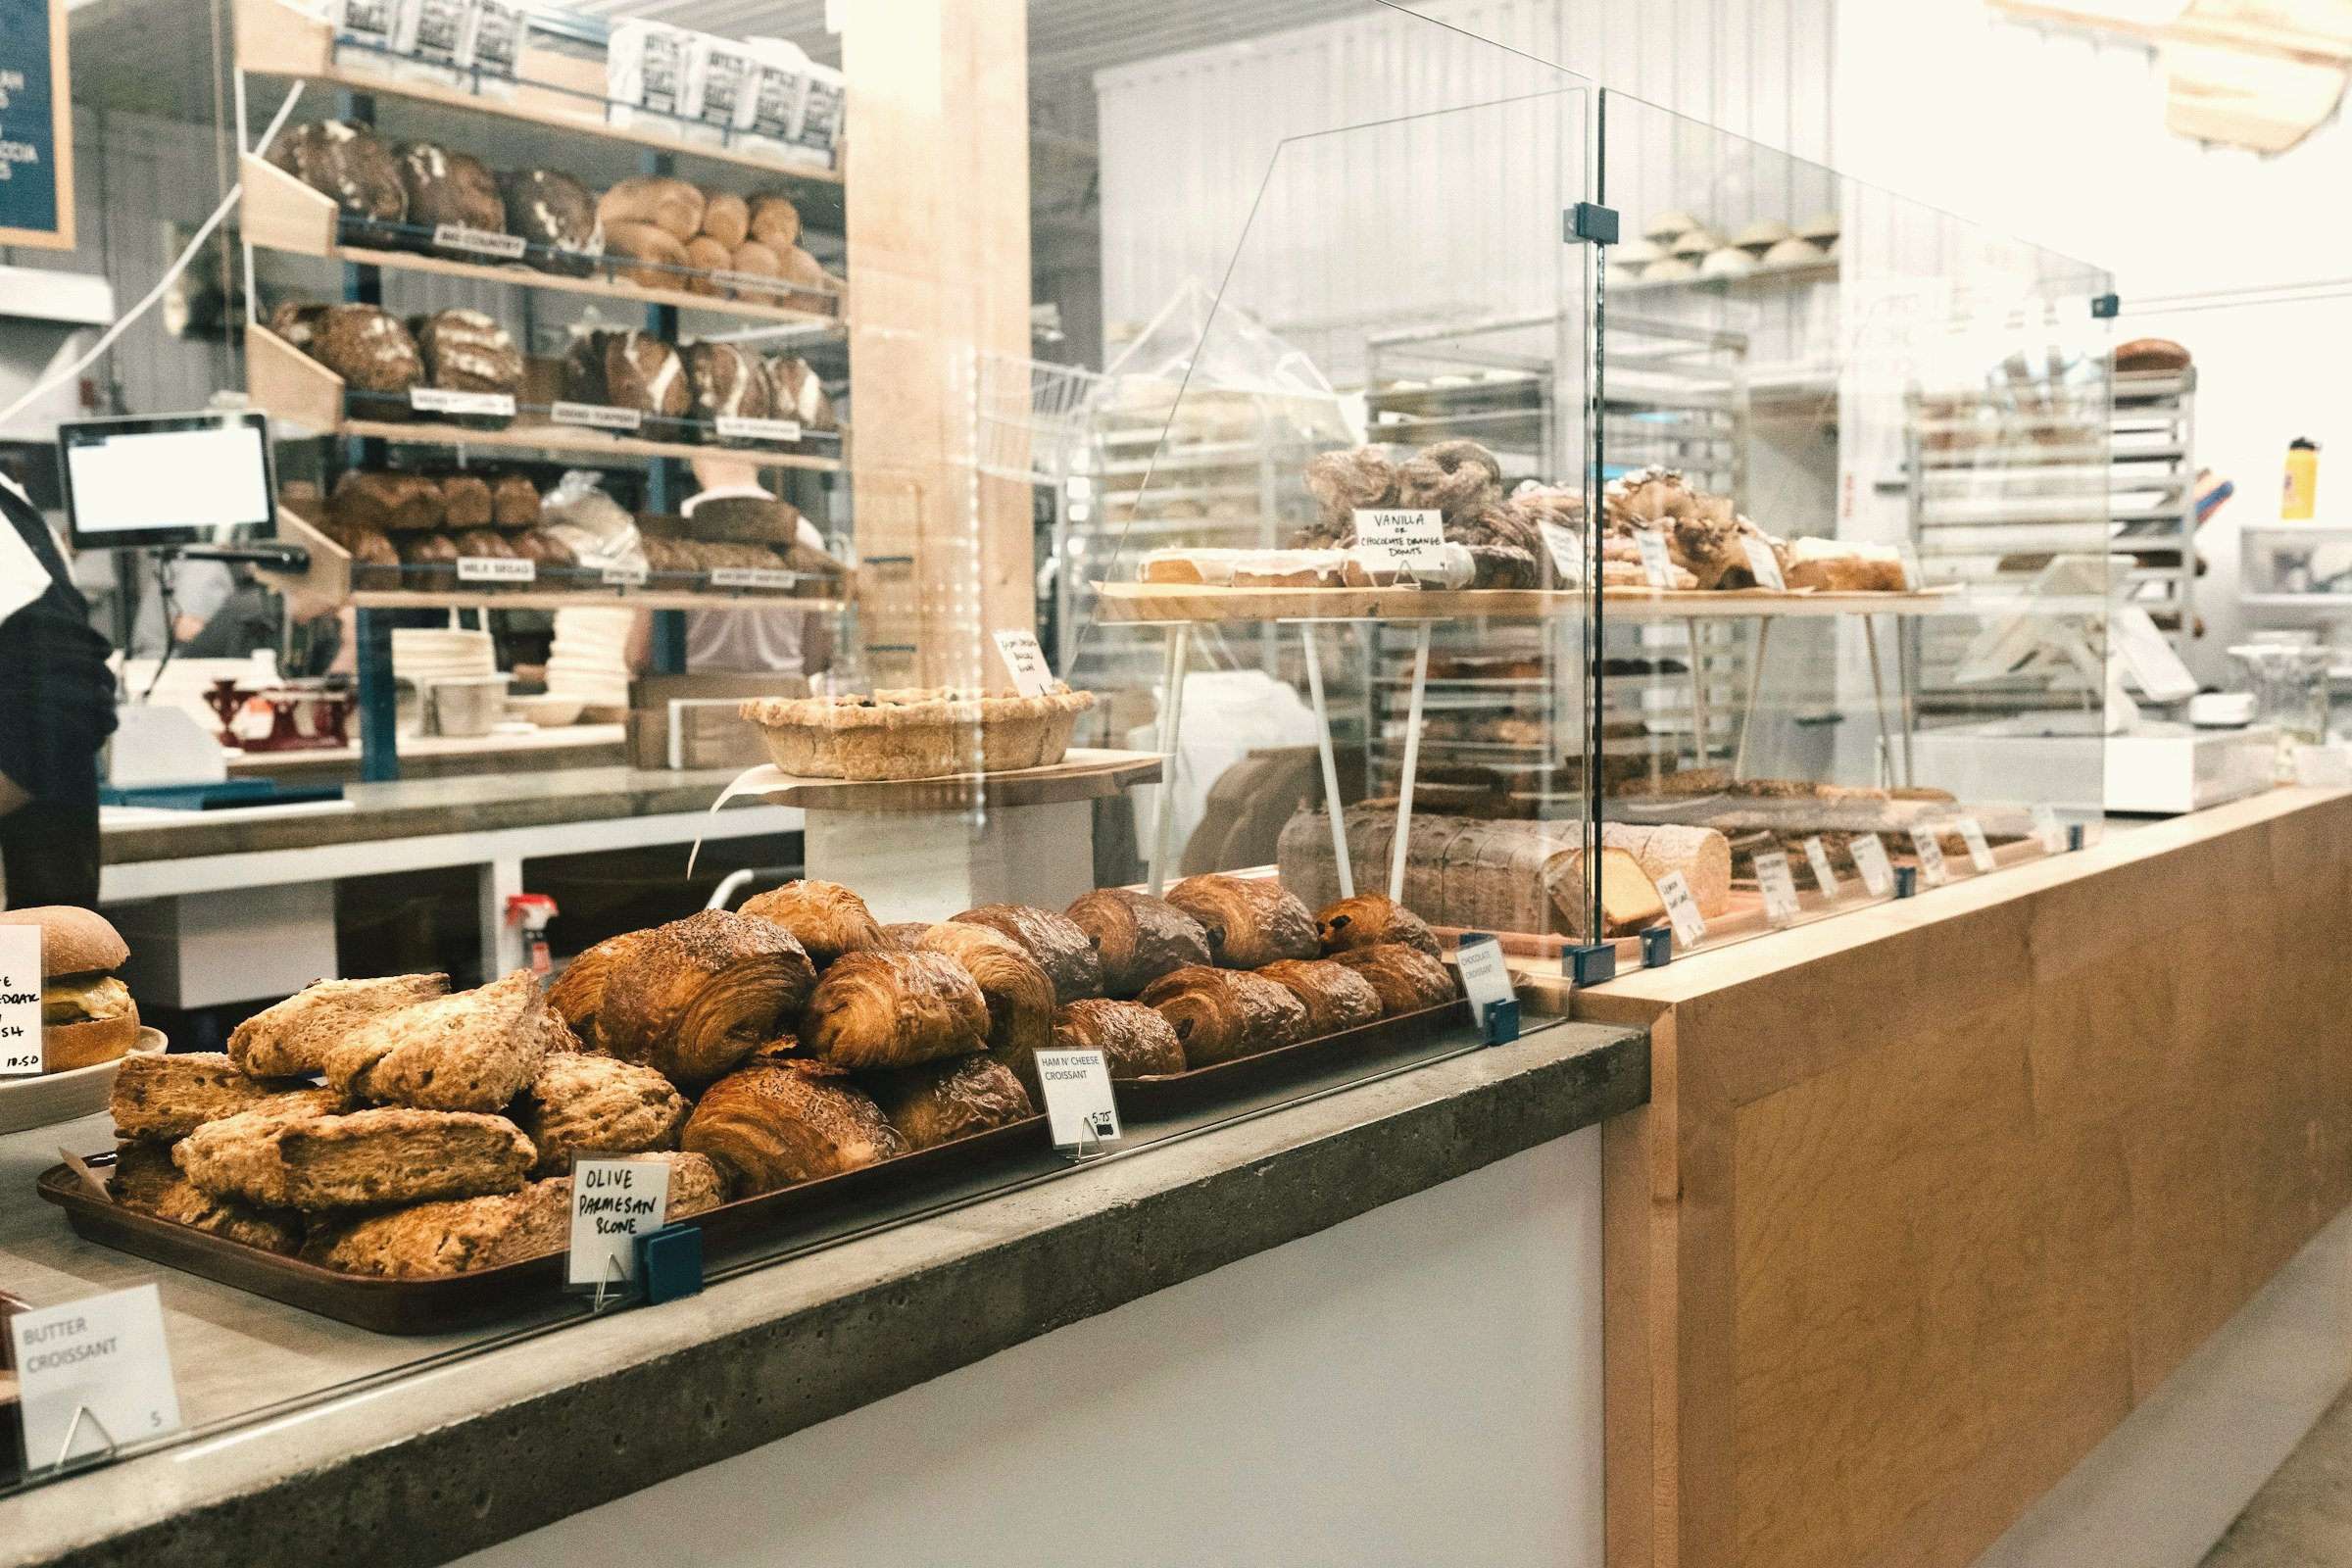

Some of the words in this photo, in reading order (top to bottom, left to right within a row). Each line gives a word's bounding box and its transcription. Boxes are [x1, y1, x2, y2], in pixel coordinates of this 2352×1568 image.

[1374, 514, 1424, 527] VANILLA
[1361, 536, 1403, 547] CHOCOLATE
[1389, 546, 1422, 558] DONUTS
[1461, 950, 1492, 966] CHOCOLATE
[1465, 963, 1494, 981] CROISSANT
[1042, 1057, 1060, 1067] HAM
[1061, 1056, 1069, 1066] N'
[1070, 1055, 1100, 1065] CHEESE
[1045, 1070, 1088, 1081] CROISSANT
[1092, 1110, 1111, 1124] 5.75
[586, 1168, 633, 1190] OLIVE
[579, 1195, 657, 1216] PARMESAN
[596, 1217, 638, 1235] SCONE
[23, 1316, 88, 1347] BUTTER
[26, 1337, 119, 1374] CROISSANT
[150, 1409, 163, 1428] 5
